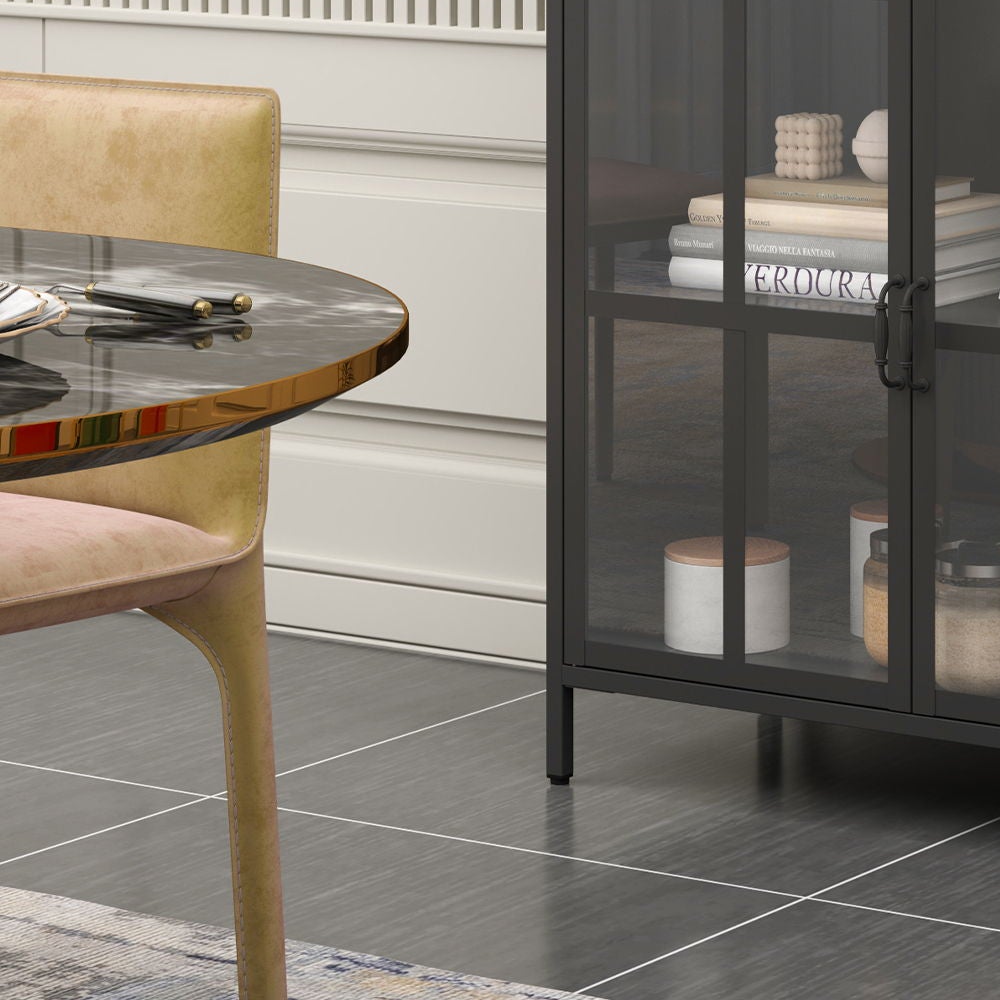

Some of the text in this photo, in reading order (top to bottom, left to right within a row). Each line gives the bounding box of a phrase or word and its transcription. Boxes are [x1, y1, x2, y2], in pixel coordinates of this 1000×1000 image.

[747, 243, 836, 258] VIAGGIO NELLA FANTASIA
